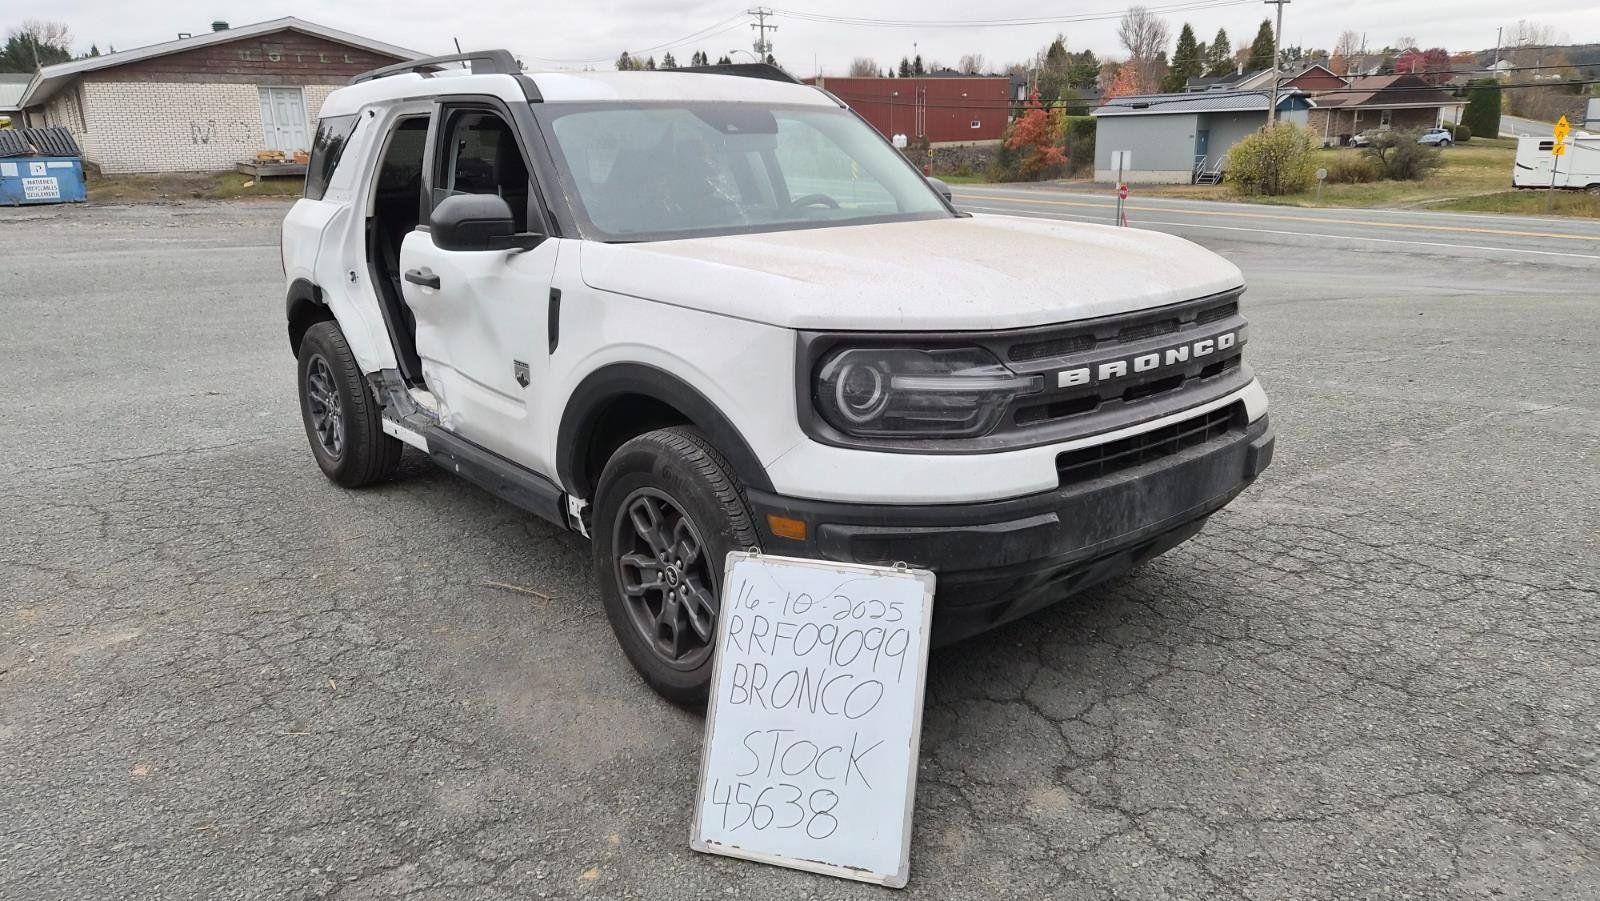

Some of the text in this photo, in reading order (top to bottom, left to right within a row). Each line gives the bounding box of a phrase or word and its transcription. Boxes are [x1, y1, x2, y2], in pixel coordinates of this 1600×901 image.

[1057, 332, 1235, 388] BRONCO
[726, 614, 910, 684] RRF09099
[729, 662, 884, 720] BRONCO
[735, 729, 885, 790] STOCK
[712, 778, 839, 839] 45638
